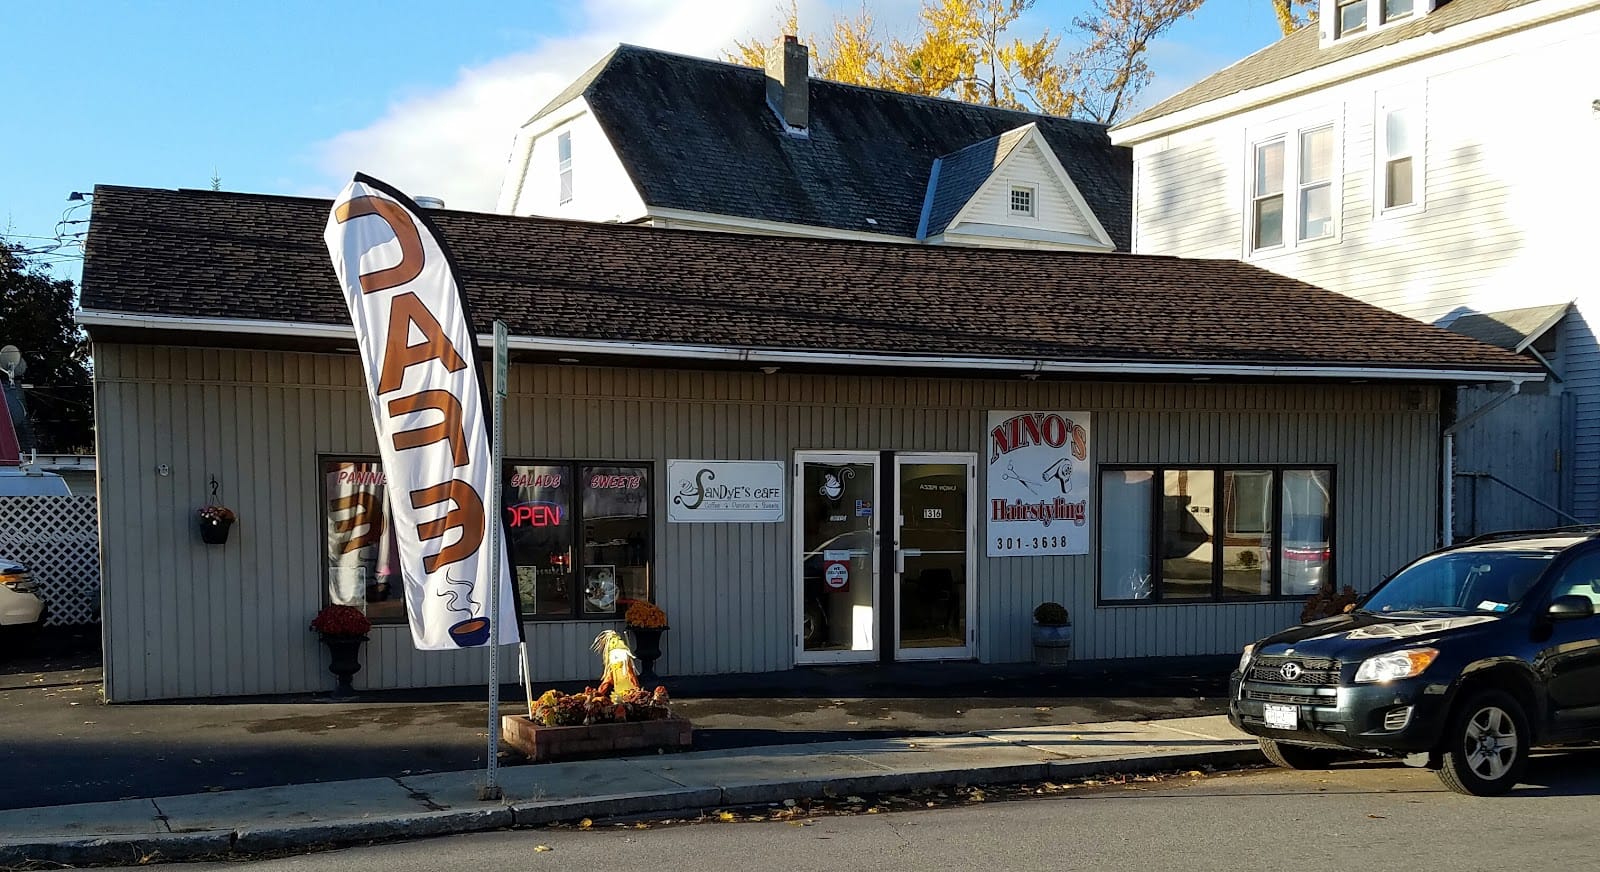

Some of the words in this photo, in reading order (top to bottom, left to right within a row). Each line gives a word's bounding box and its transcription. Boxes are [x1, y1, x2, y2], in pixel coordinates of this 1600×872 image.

[990, 412, 1087, 465] NINO'S
[510, 473, 561, 489] SALADS
[591, 474, 640, 489] SWEETS
[924, 509, 942, 519] 1316
[991, 496, 1086, 528] Hairstyling
[997, 536, 1067, 550] 301-3638
